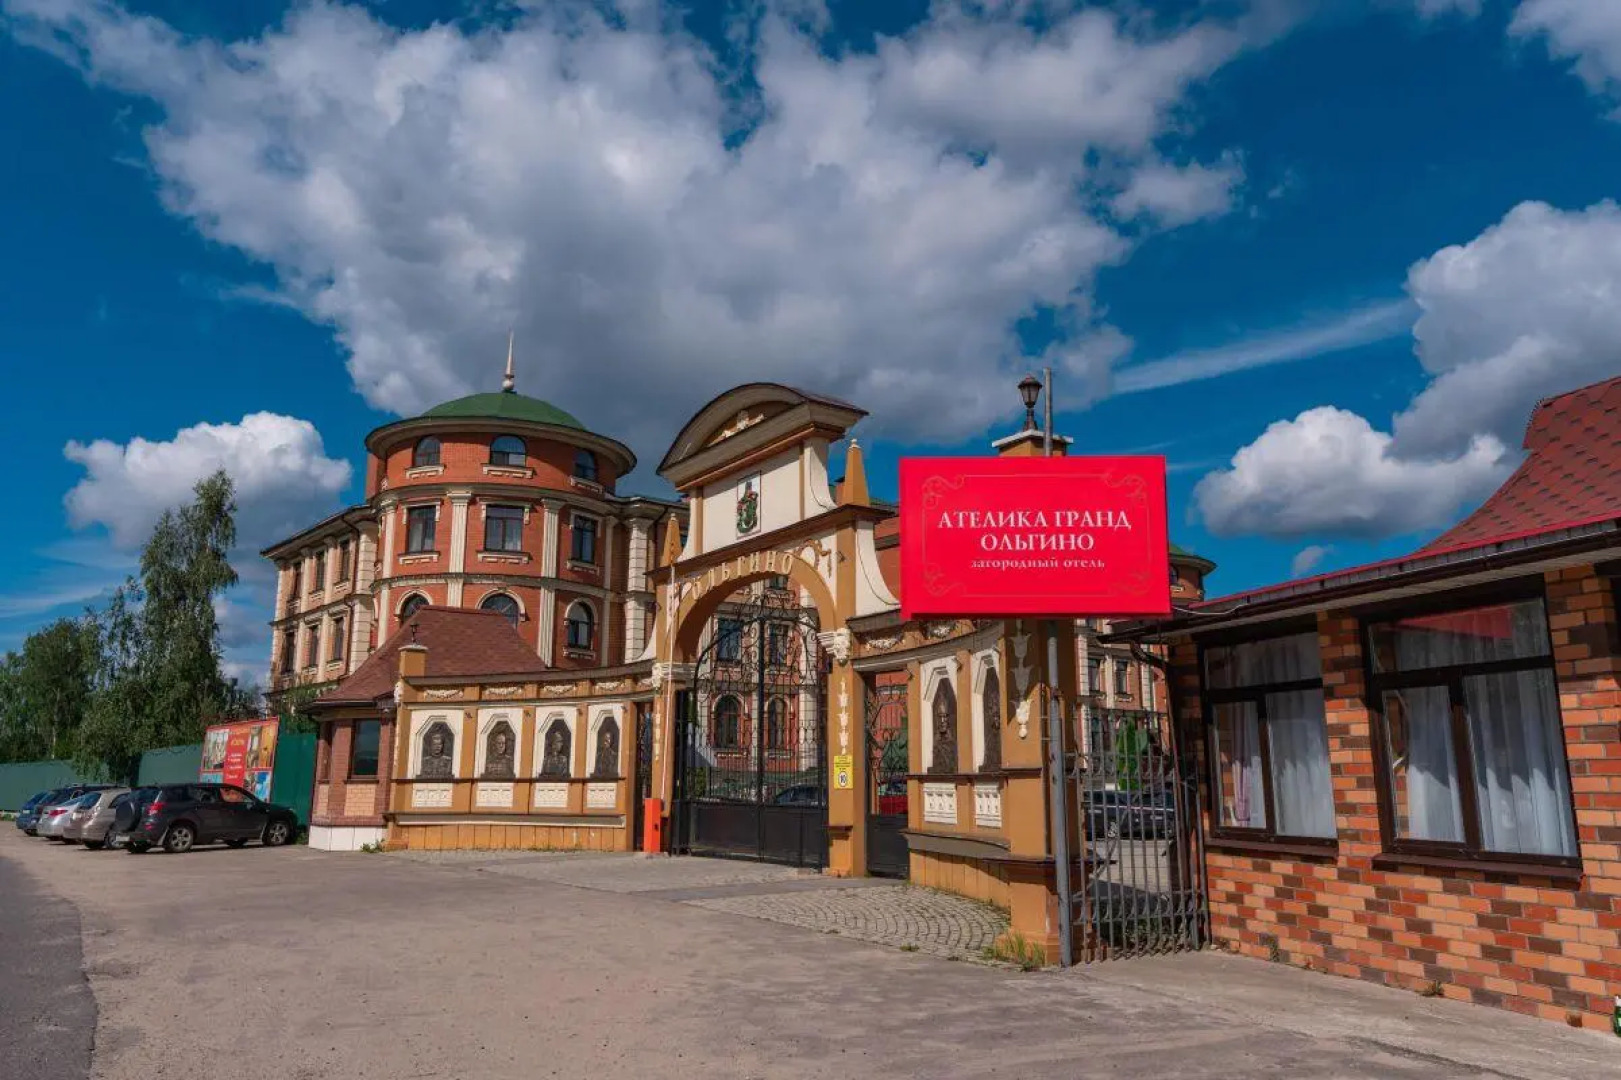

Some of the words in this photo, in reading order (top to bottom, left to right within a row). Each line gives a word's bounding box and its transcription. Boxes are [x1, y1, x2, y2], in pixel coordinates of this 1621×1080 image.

[938, 510, 1048, 528] АТЕЛИКА
[1054, 510, 1132, 530] ГРАНД
[980, 533, 1094, 551] ОЛЬГИНО
[971, 557, 1058, 571] загородный
[1063, 558, 1105, 568] отель
[691, 551, 793, 600] ОЛЬГИНО
